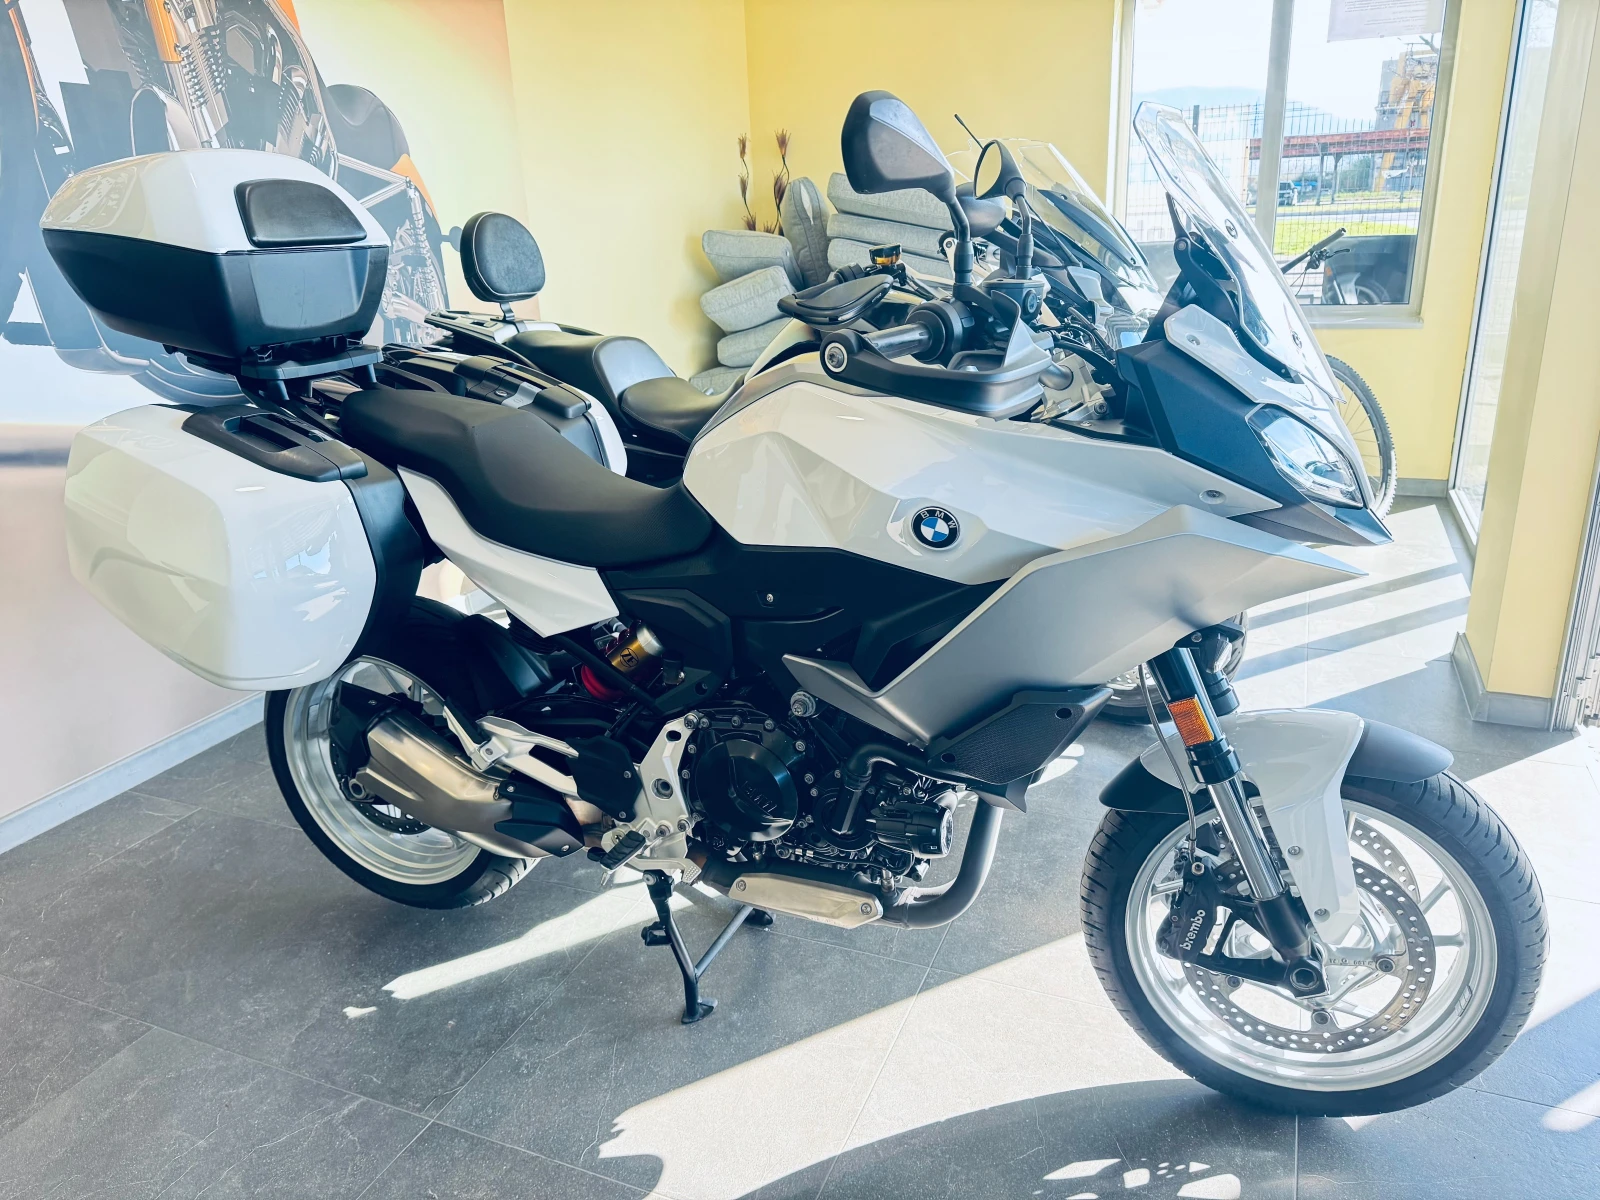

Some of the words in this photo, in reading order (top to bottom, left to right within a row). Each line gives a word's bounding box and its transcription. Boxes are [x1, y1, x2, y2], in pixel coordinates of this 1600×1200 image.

[920, 510, 957, 529] BMW
[620, 648, 639, 667] ZF
[1179, 909, 1206, 950] brembo
